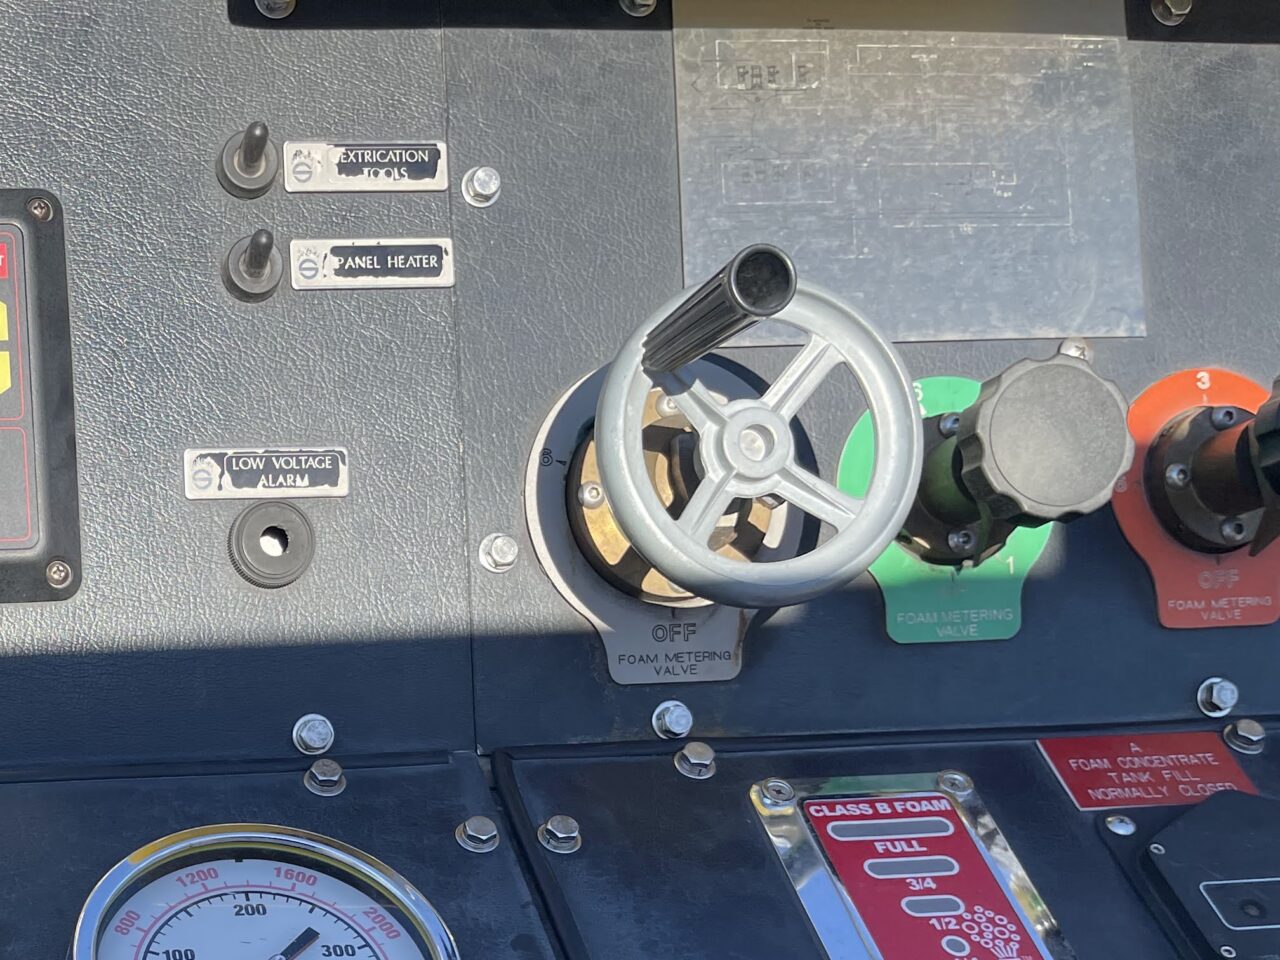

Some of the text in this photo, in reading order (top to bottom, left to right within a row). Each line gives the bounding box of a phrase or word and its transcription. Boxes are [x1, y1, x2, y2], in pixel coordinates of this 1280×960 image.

[339, 150, 429, 163] EXTRICATION
[362, 167, 408, 181] TOOLS
[336, 255, 438, 269] PANEL HEATER
[232, 456, 332, 470] LOW VOLTAGE
[259, 474, 309, 487] ALARM
[652, 623, 697, 642] OFF
[618, 650, 732, 665] FOAM METERING
[653, 664, 698, 676] VALVE
[1068, 753, 1219, 772] FOAM CONCENTRATE
[1107, 769, 1201, 784] TANK FILL
[1087, 786, 1170, 800] NORMALLY
[809, 799, 951, 818] CLASS B FOAM
[874, 840, 928, 854] FULL
[176, 867, 220, 888] 1200
[273, 866, 318, 887] 1600
[908, 878, 937, 891] 3/4
[233, 903, 267, 917] 200
[929, 917, 960, 931] 1/2
[321, 944, 356, 957] 300
